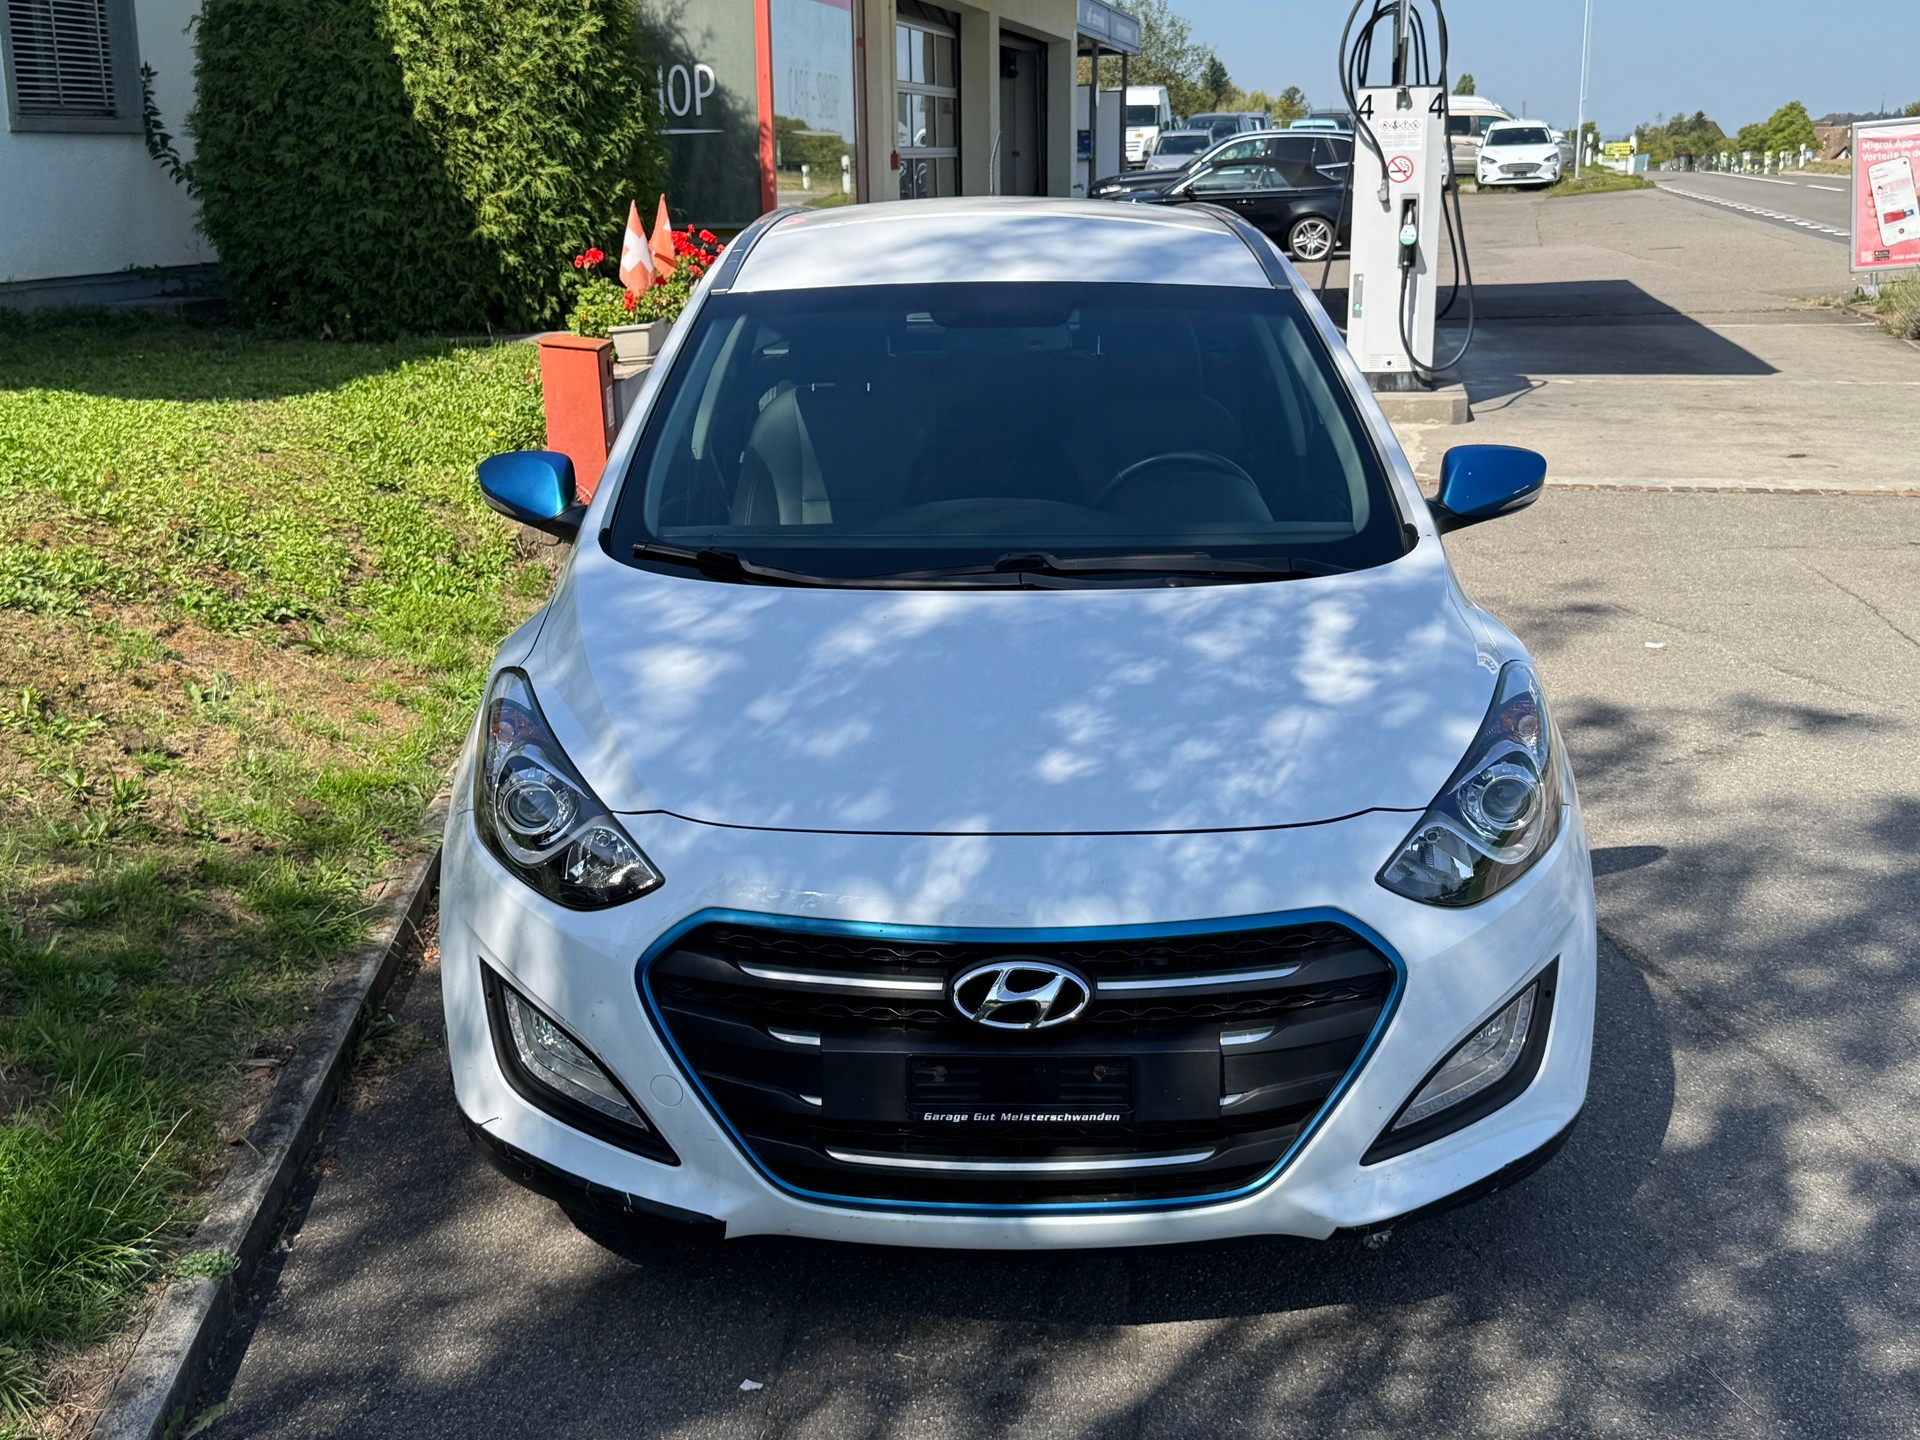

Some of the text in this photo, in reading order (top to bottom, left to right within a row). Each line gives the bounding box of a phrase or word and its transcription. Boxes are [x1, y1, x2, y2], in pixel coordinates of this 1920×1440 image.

[1357, 94, 1374, 121] 4
[1428, 93, 1445, 119] 4
[1862, 141, 1893, 151] Migrol
[1894, 139, 1913, 149] App
[1861, 150, 1899, 162] Vorteile
[1901, 148, 1910, 158] in
[923, 1112, 1121, 1123] Garage Gut Meisterschwanden
